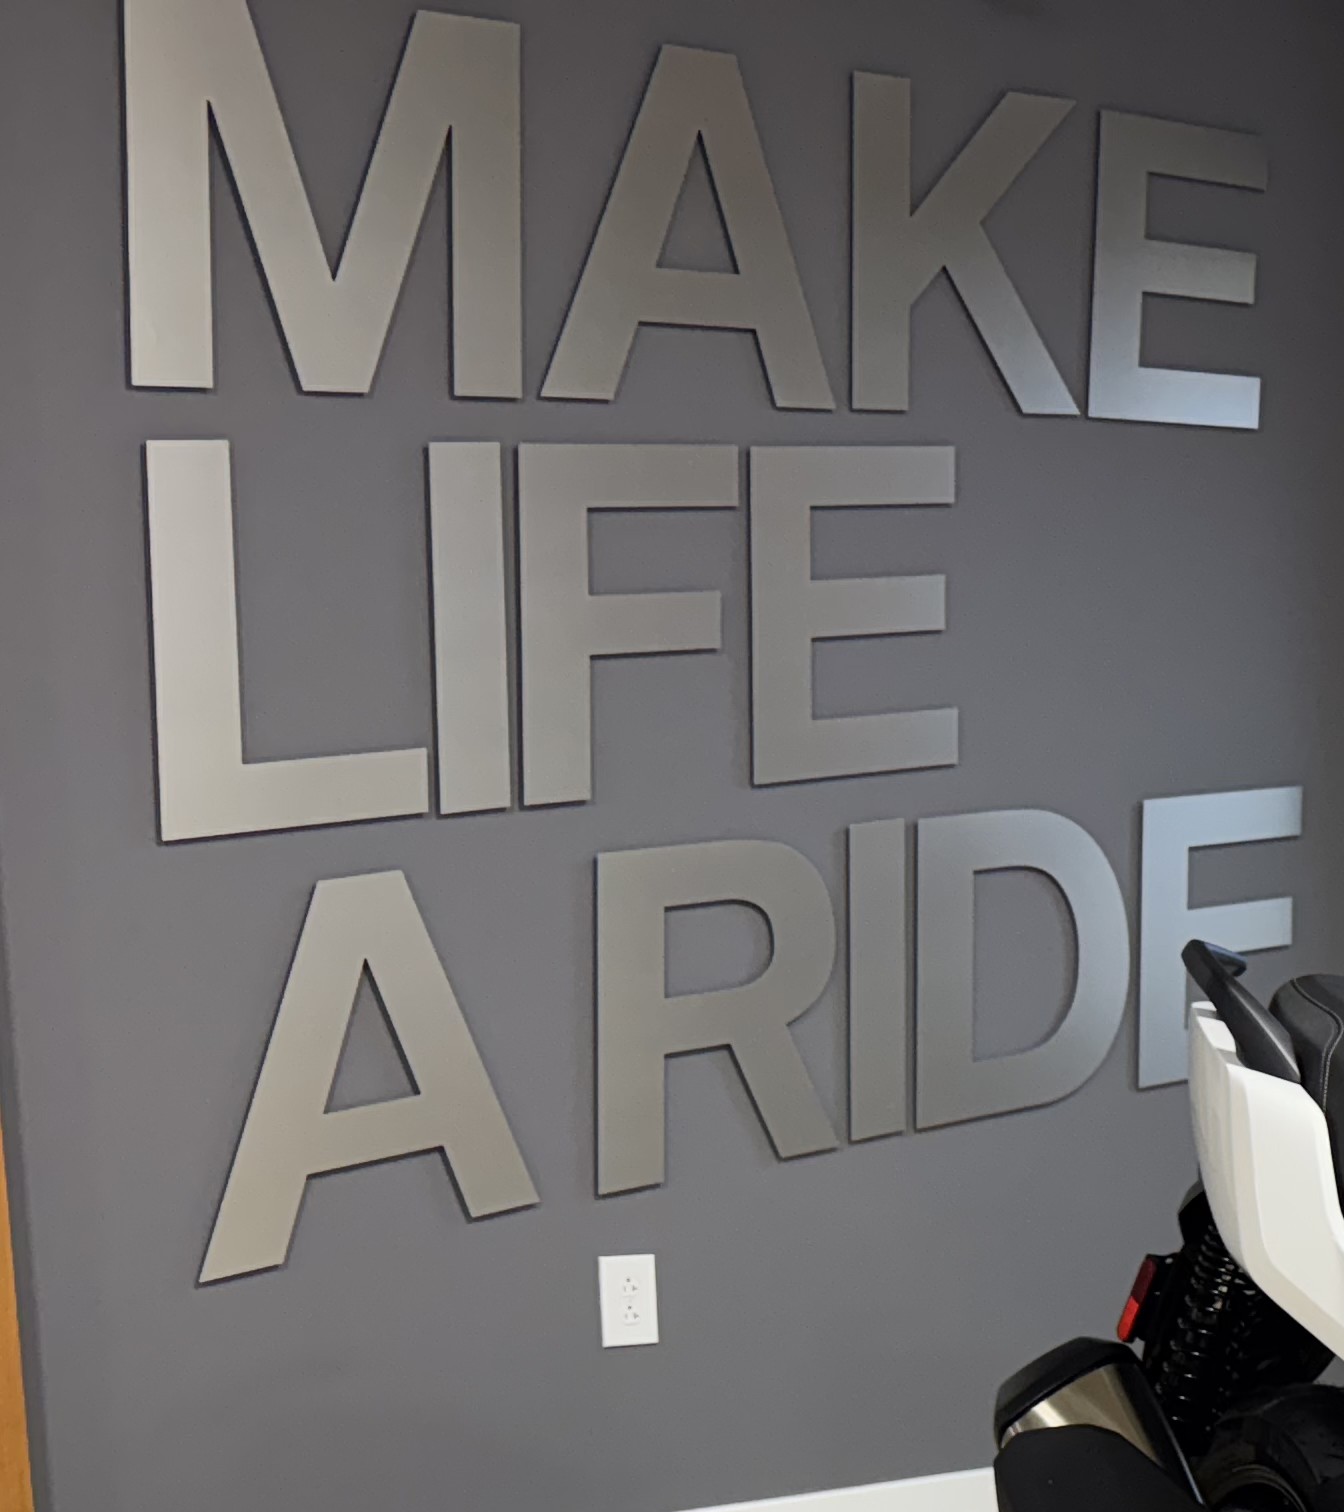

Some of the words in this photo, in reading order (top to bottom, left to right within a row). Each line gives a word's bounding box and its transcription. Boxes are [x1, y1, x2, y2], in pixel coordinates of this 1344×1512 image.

[122, 0, 1268, 430] MAKE
[144, 438, 960, 844] LIFE
[197, 868, 541, 1287] A
[593, 784, 1304, 1199] RIDE
